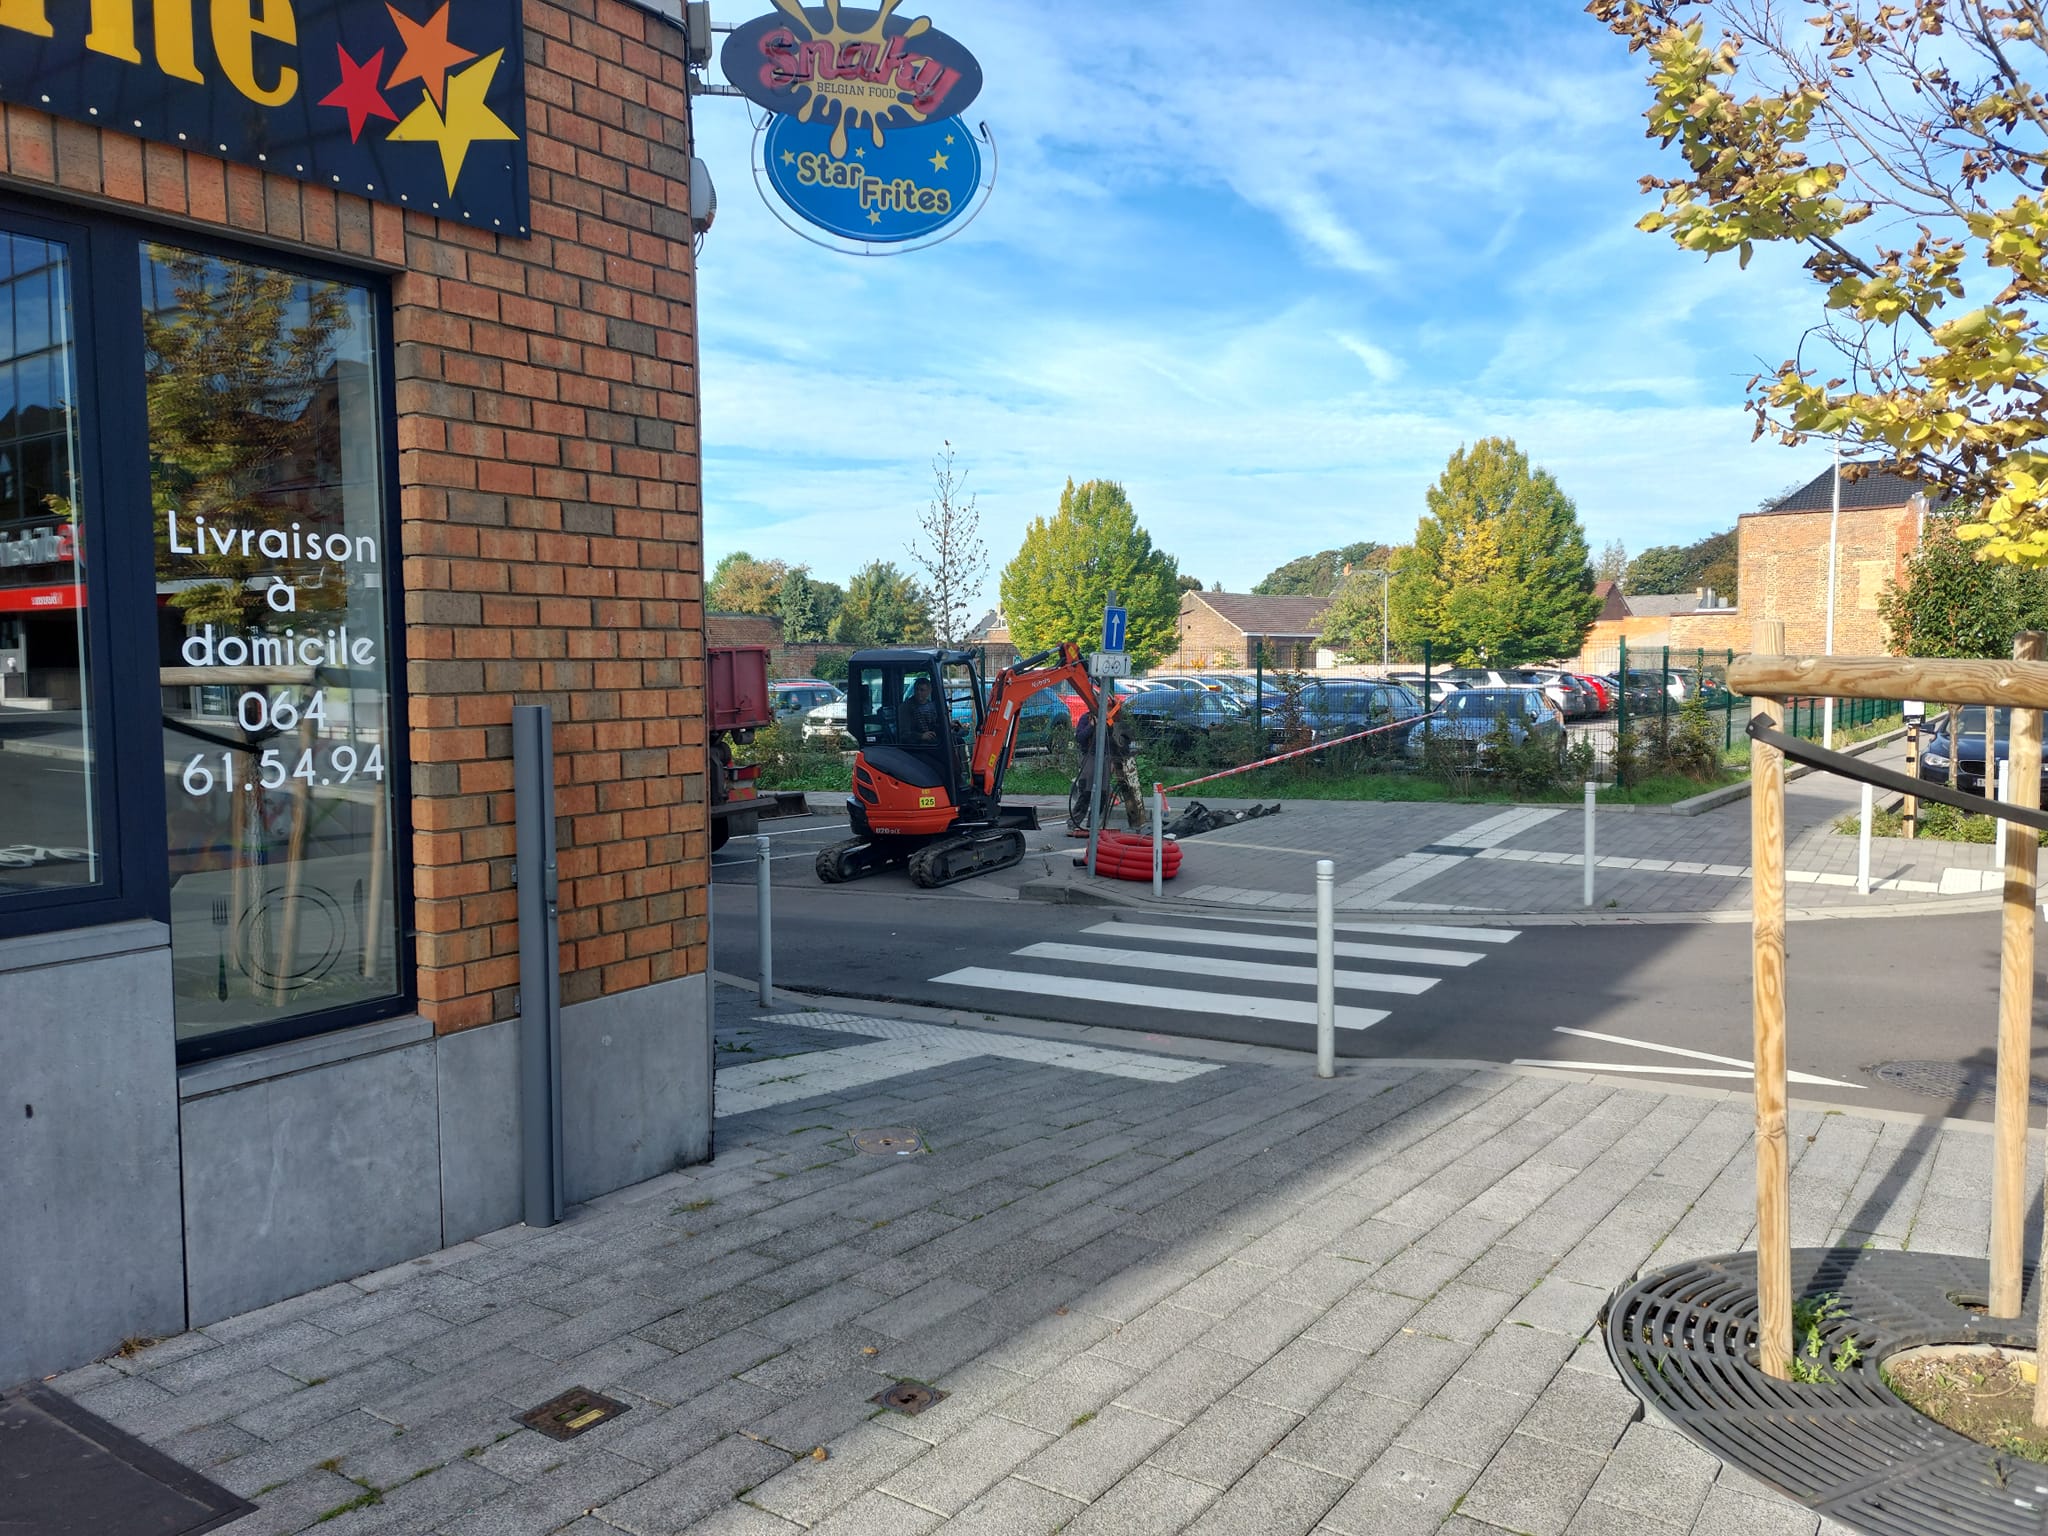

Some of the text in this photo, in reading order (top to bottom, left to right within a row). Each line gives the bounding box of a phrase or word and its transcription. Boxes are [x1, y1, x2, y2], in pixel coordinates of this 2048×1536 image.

[758, 27, 962, 112] Snaky
[816, 81, 897, 99] BELGIAN FOOD
[798, 153, 951, 213] Star Frites
[168, 510, 377, 563] Livraison
[267, 576, 296, 612] à
[181, 623, 377, 666] domicile
[238, 690, 327, 732] 064
[183, 744, 384, 796] 61.54.94
[920, 798, 935, 806] 125
